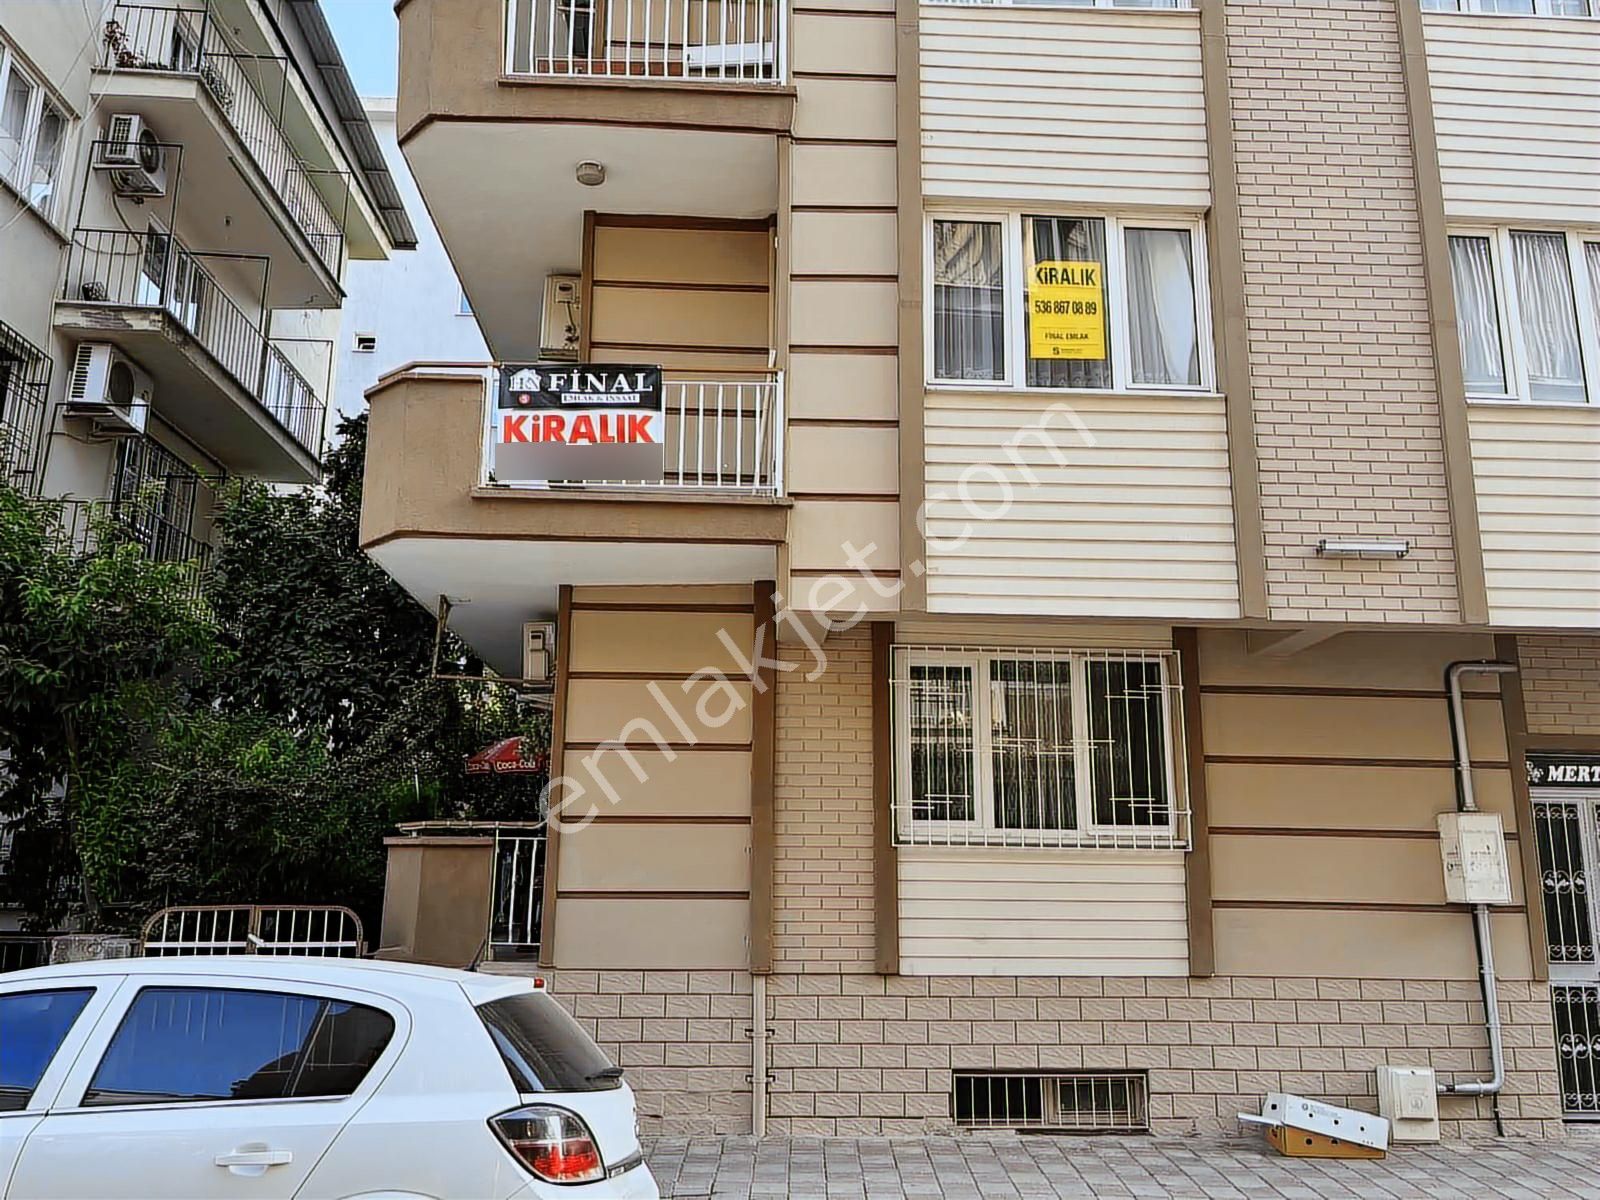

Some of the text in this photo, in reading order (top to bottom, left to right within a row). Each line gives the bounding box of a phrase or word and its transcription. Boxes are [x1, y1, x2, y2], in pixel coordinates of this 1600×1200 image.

[1035, 300, 1052, 314] 536
[1085, 302, 1097, 315] 89
[548, 369, 653, 392] FİNAL
[1547, 765, 1600, 782] MERT
